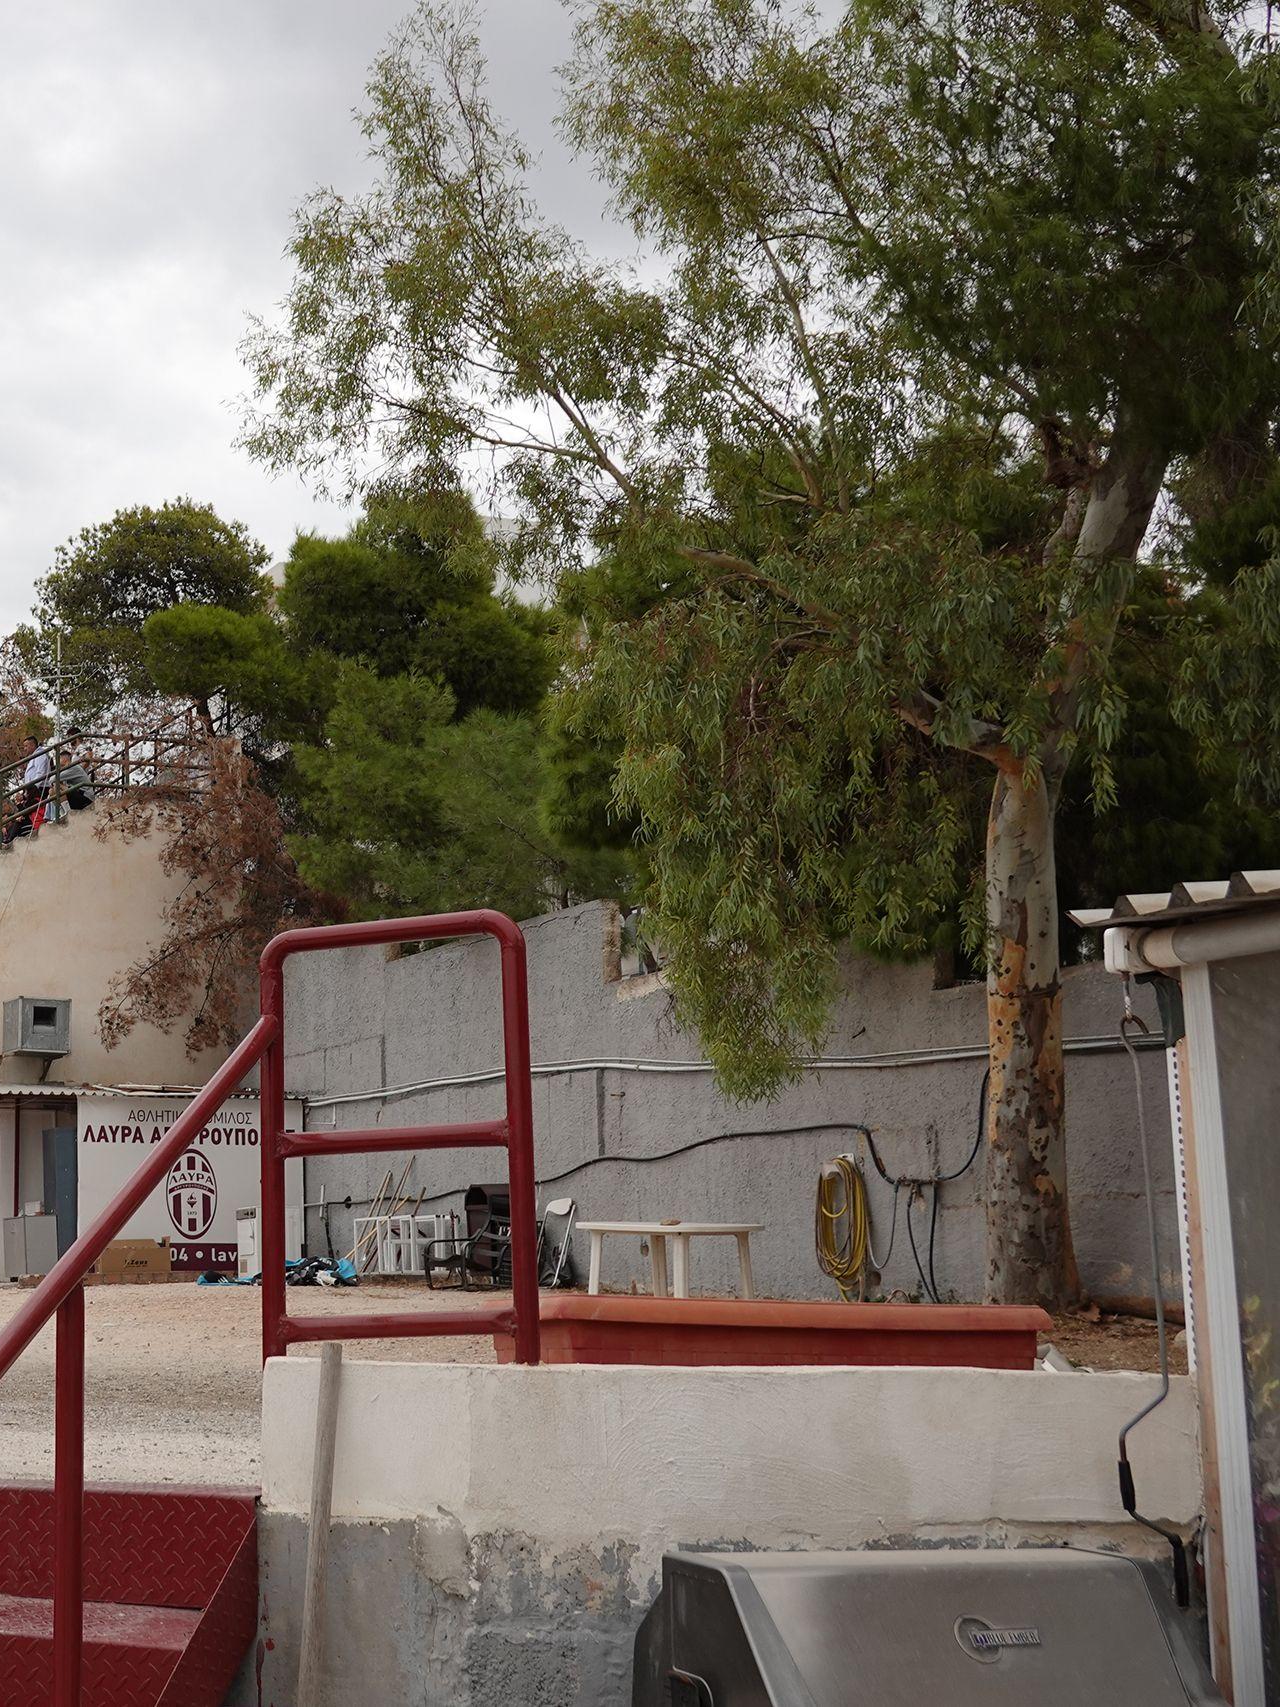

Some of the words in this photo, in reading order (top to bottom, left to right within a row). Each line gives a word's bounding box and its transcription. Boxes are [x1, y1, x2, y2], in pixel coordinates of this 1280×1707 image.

[128, 1109, 184, 1122] ΑΘΛΗΤΙΚ
[83, 1125, 144, 1144] ΛΑΥΡΑ
[169, 1172, 214, 1186] ΛΑΥΡΑ
[170, 1248, 188, 1262] 04
[211, 1247, 238, 1262] lav
